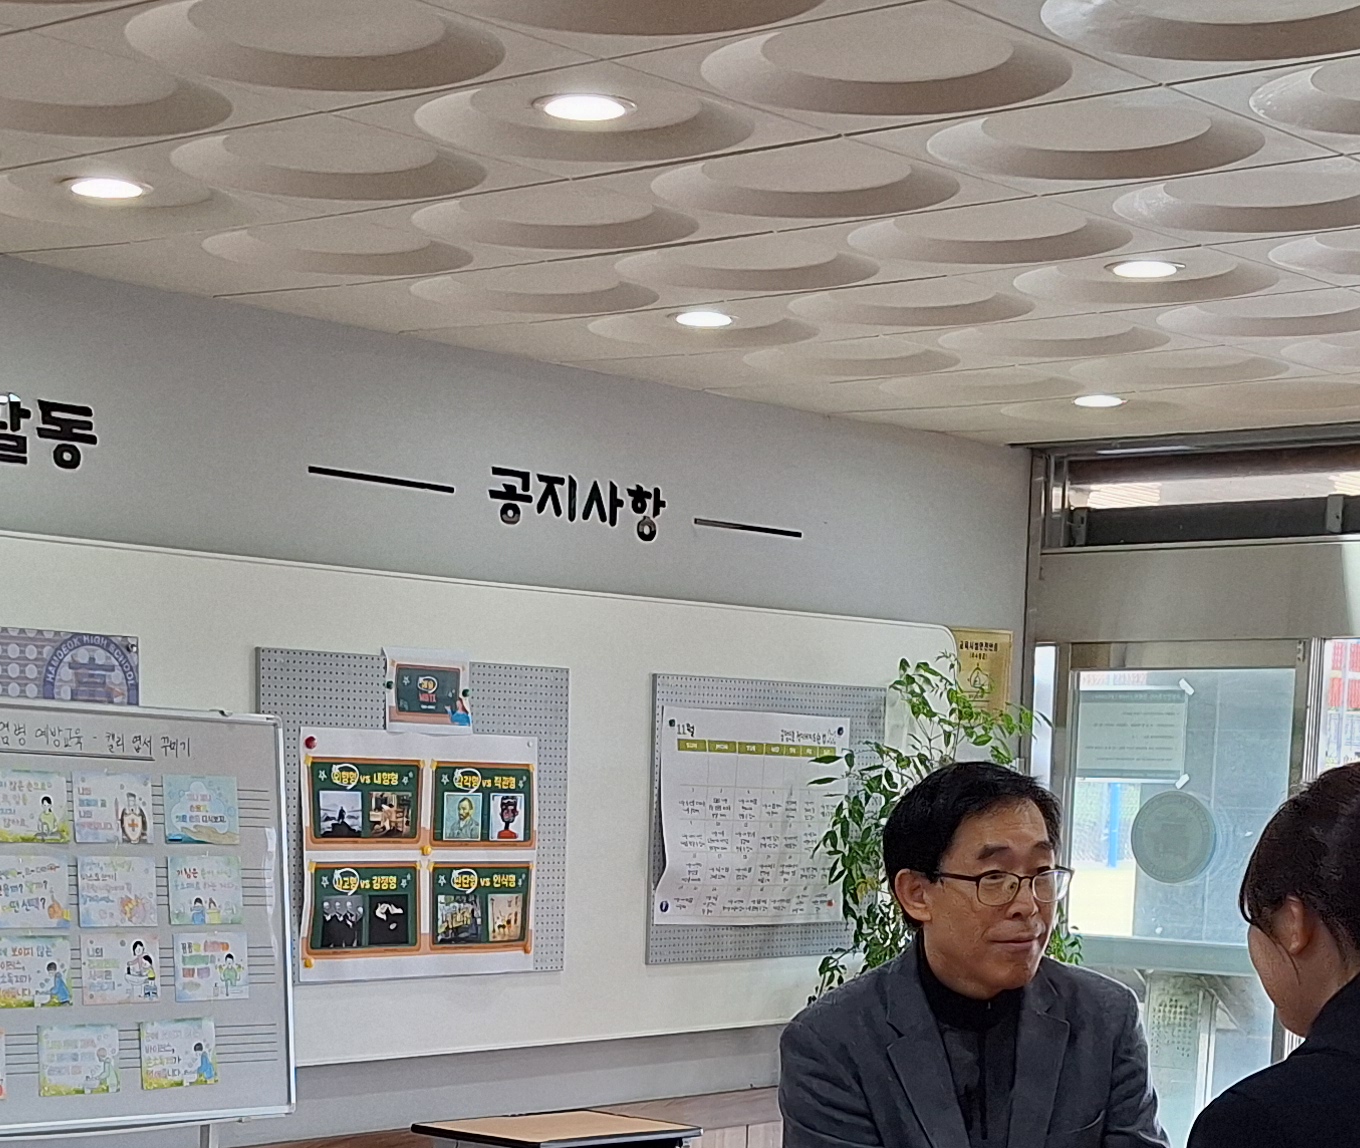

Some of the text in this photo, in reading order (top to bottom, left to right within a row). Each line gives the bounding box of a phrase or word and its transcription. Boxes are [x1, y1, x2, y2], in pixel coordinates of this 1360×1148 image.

[488, 466, 667, 543] 공지사항
[34, 723, 84, 751] 예방교육
[160, 736, 190, 758] 꾸미기
